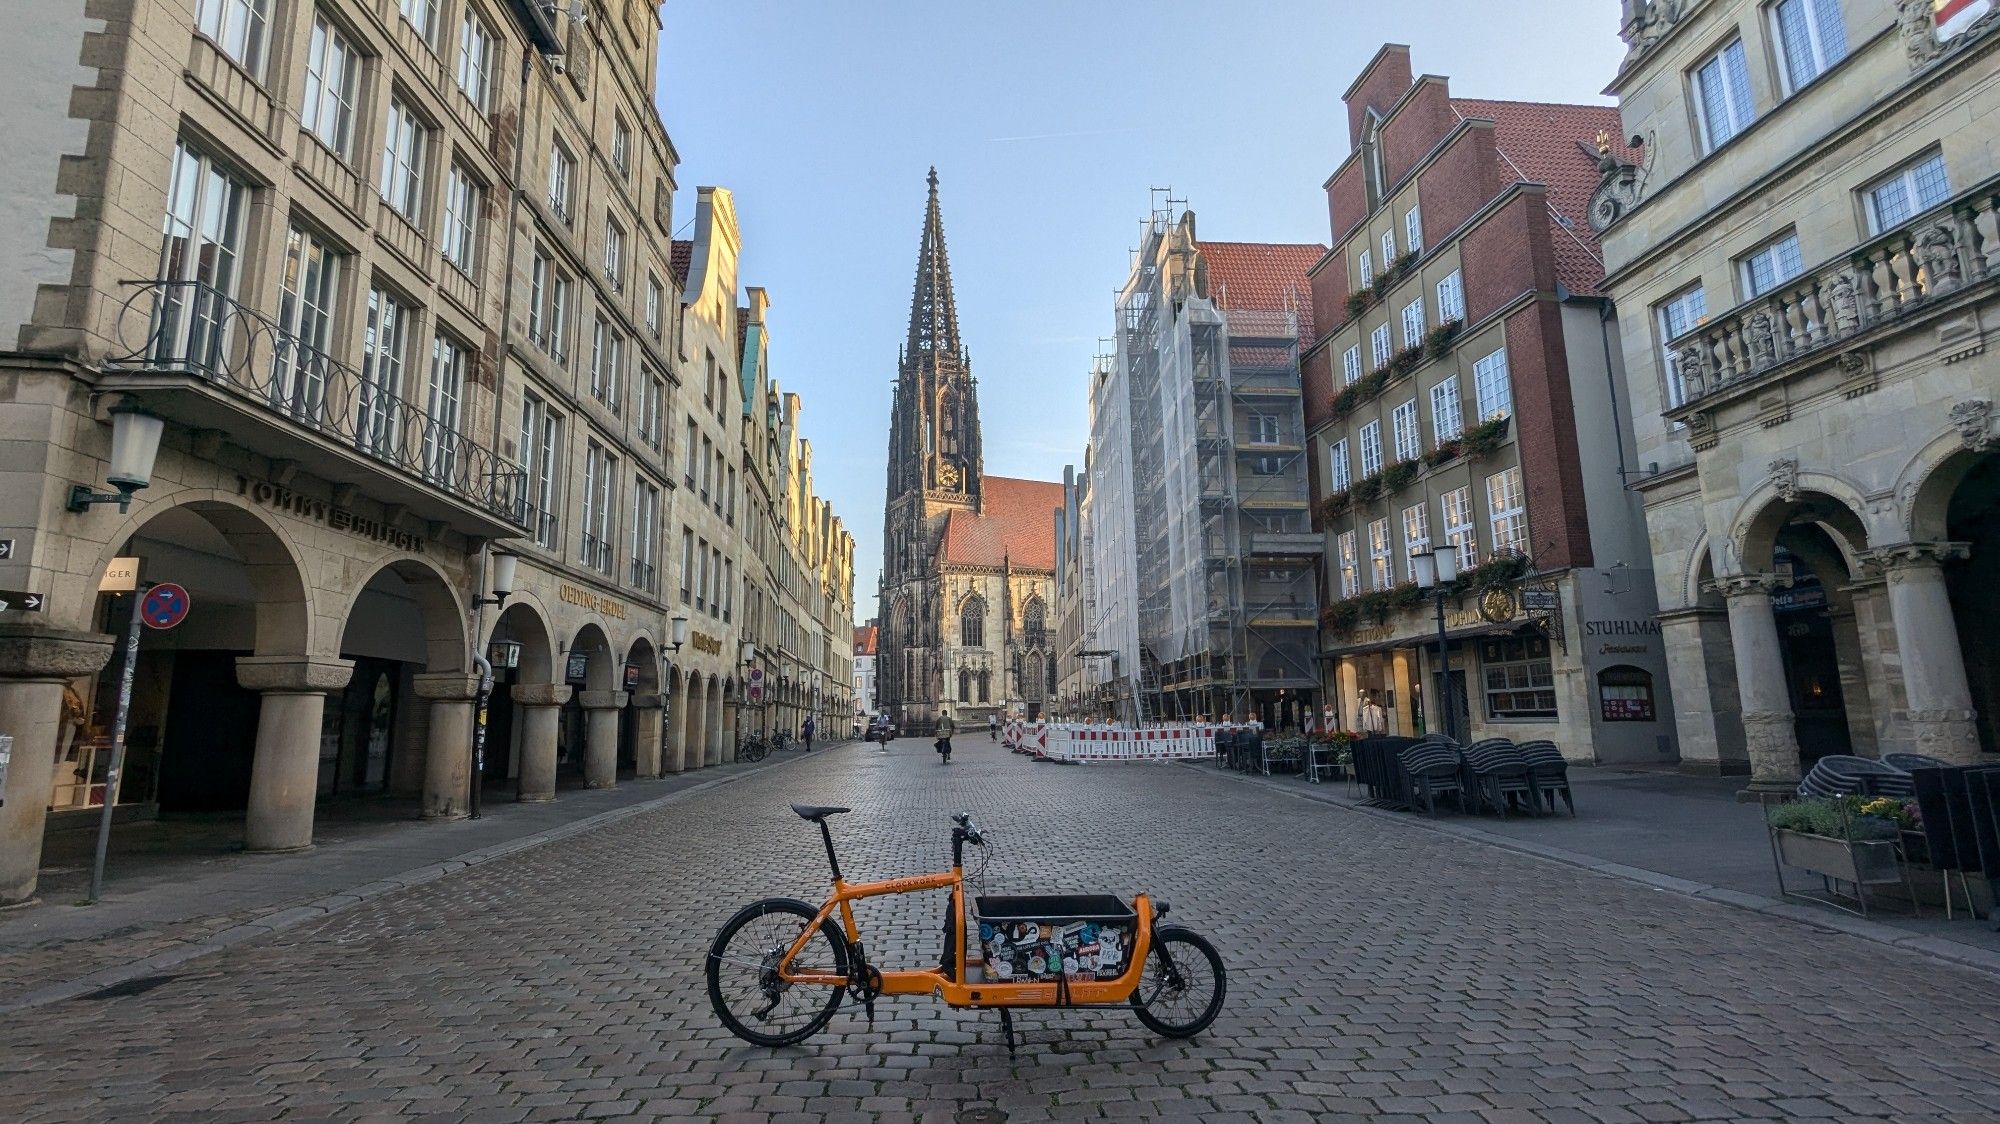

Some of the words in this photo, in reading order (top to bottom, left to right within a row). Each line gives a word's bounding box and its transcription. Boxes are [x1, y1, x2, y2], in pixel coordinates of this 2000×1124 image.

[237, 474, 332, 527] TOMMY
[351, 515, 426, 554] HILFIGER
[559, 583, 626, 621] OEDING-ERDEL
[885, 877, 936, 890] CLOCKWORK
